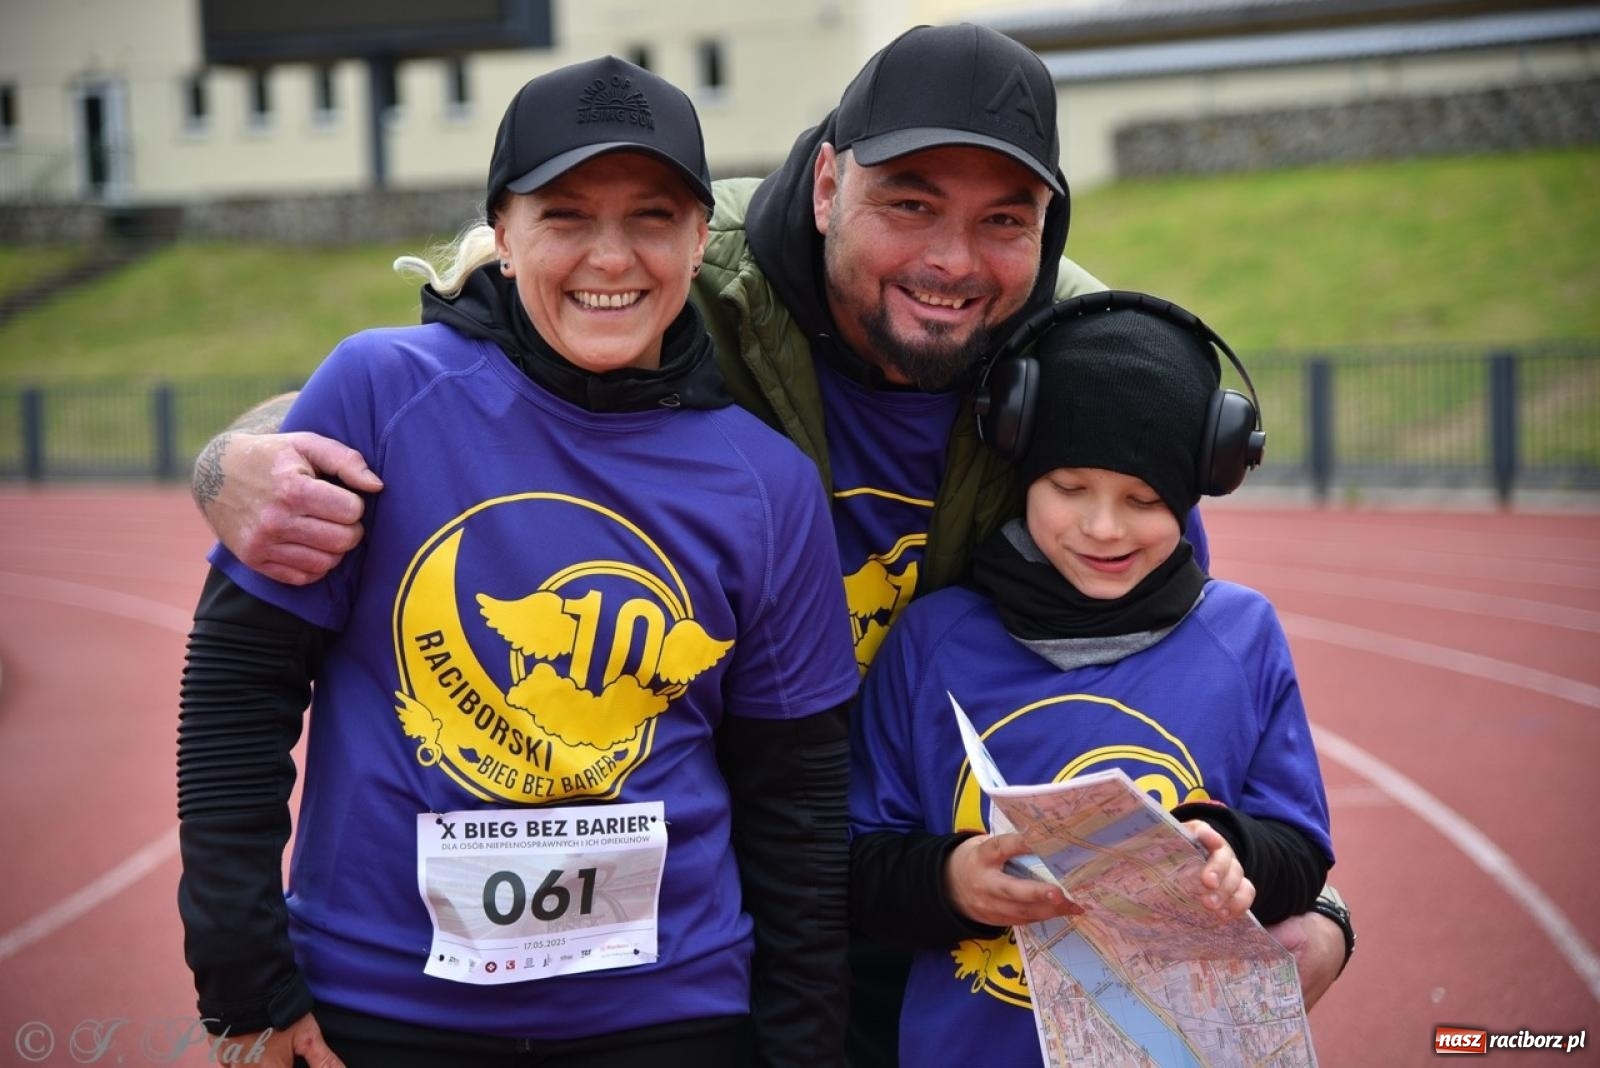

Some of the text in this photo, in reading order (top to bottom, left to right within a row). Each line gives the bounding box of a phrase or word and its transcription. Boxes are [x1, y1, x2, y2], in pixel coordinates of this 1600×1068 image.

[611, 74, 631, 90] OF
[576, 109, 655, 132] RISING SUN
[561, 589, 666, 692] 10
[414, 629, 554, 773] RACIBORSKI
[477, 754, 619, 797] BIEG BEZ BARIER
[441, 815, 650, 840] X BIEG BEZ BARIER
[459, 840, 484, 850] OSÓB
[482, 867, 597, 926] 061
[523, 937, 566, 950] 17.05.2025
